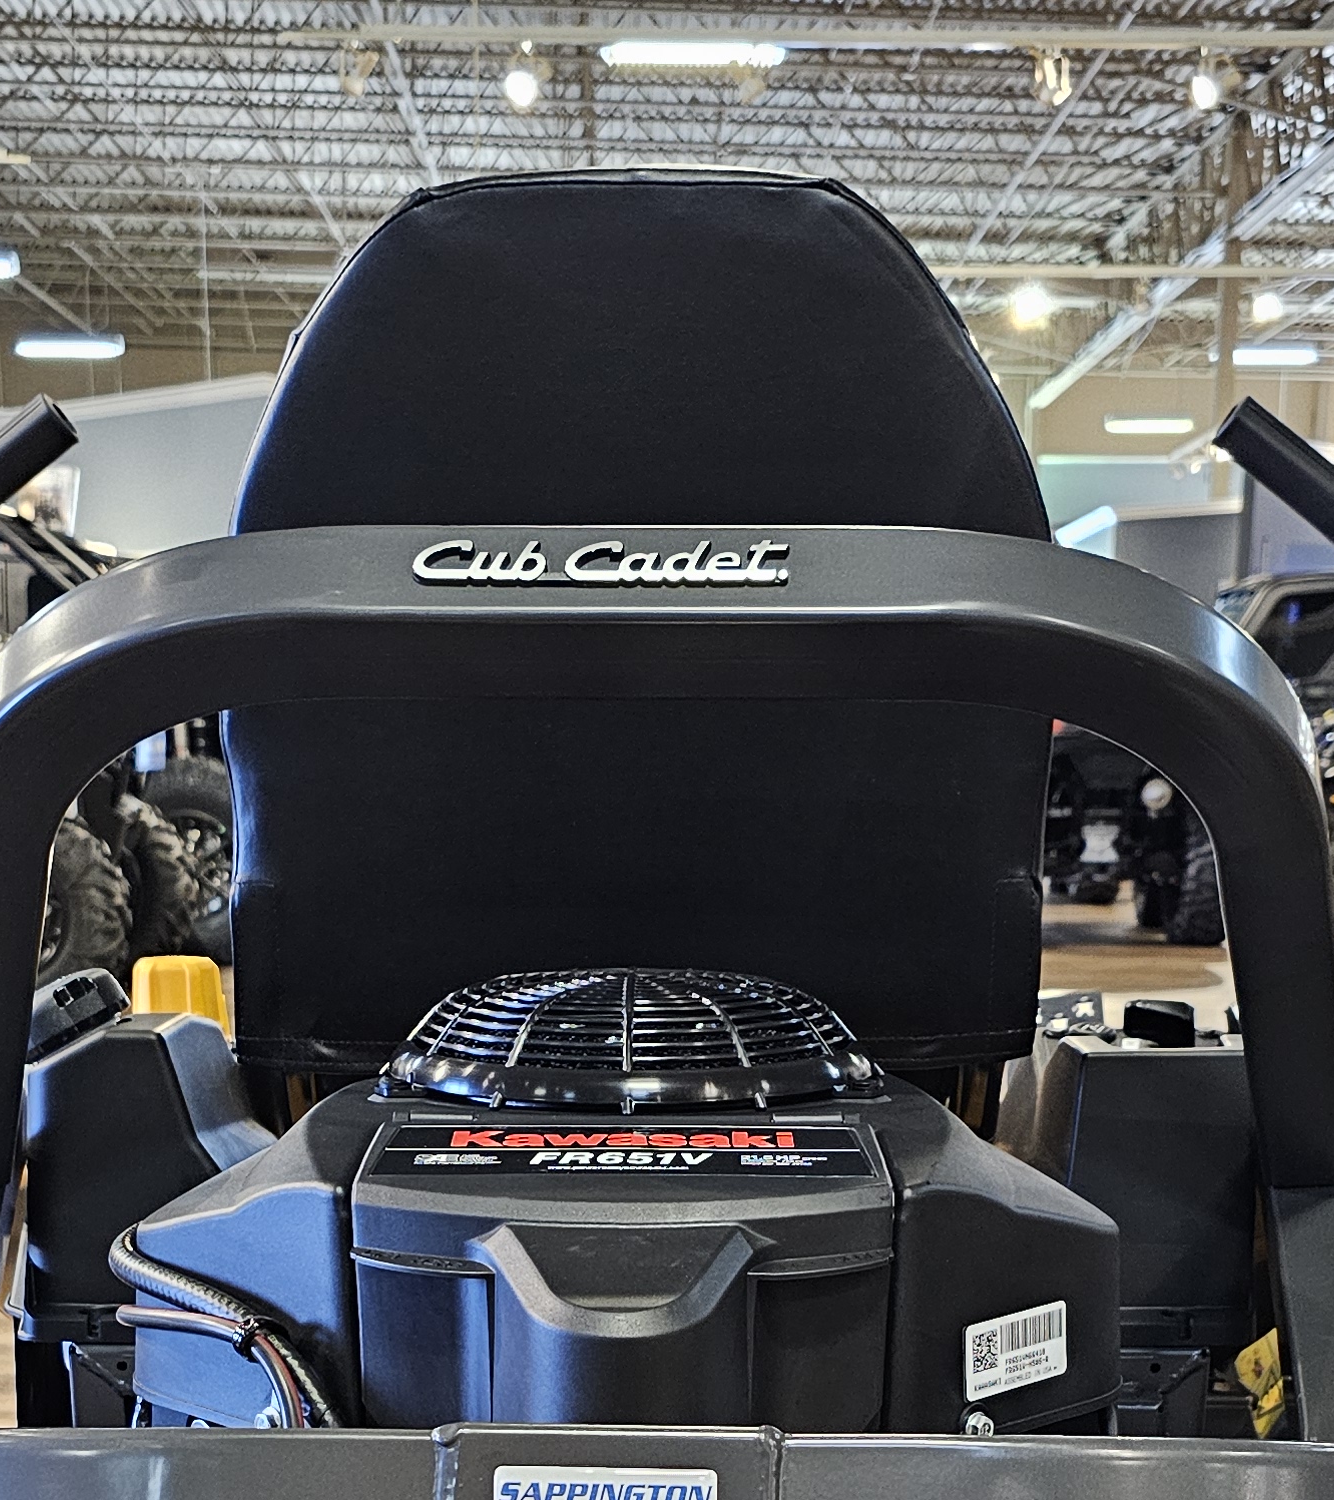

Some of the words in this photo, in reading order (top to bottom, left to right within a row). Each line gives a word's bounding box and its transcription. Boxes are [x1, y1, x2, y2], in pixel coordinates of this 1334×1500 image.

[412, 539, 548, 585] Cub
[563, 539, 789, 586] Cadet
[450, 1130, 795, 1148] Kawasaki
[529, 1152, 714, 1165] FR651V
